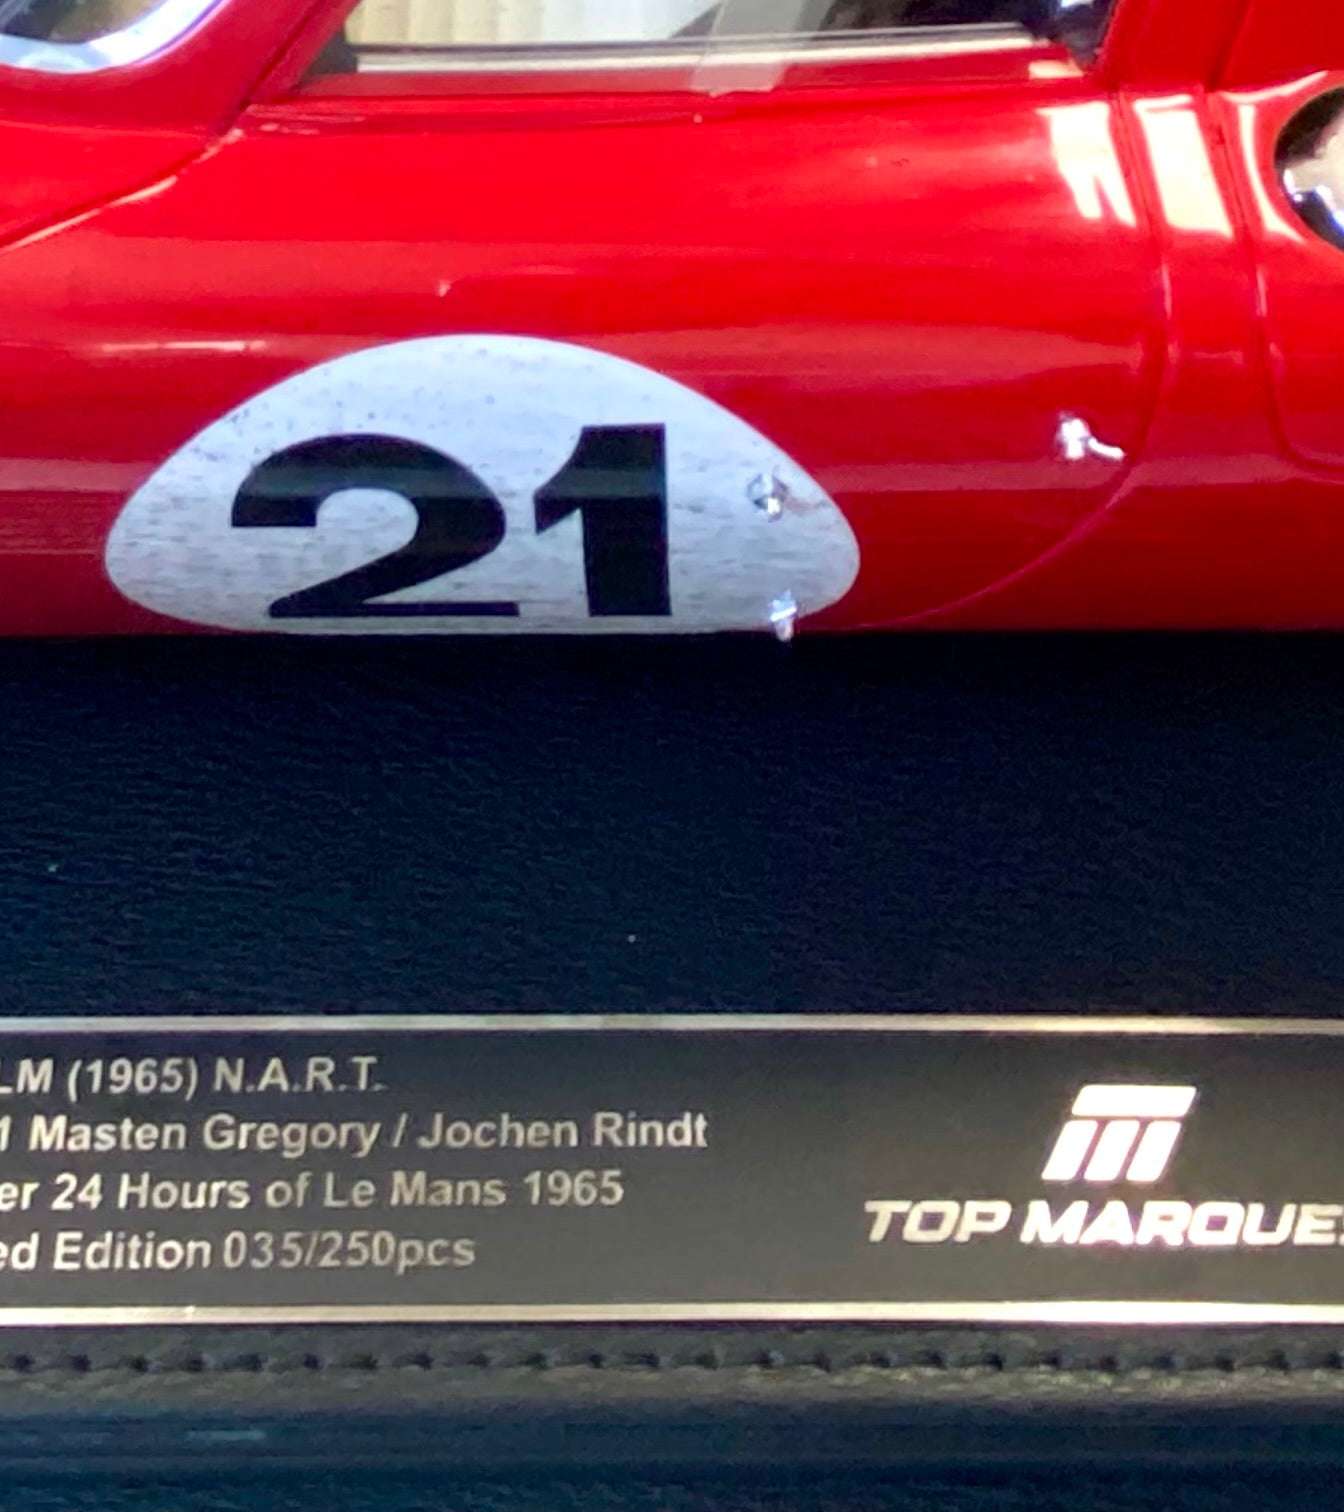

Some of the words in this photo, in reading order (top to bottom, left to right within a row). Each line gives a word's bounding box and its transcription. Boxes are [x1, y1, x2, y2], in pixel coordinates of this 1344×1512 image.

[230, 422, 671, 618] 21
[67, 1057, 198, 1103] (1965)
[213, 1055, 385, 1094] N.A.R.T.
[28, 1114, 187, 1152] Masten
[202, 1113, 382, 1159] Gregory
[391, 1112, 408, 1148] /
[417, 1112, 579, 1149] Jochen
[593, 1111, 708, 1148] Rindt
[50, 1172, 103, 1211] 24
[117, 1171, 251, 1210] Hours
[265, 1171, 312, 1208] of
[323, 1171, 376, 1208] Le
[390, 1170, 508, 1206] Mans
[523, 1169, 625, 1207] 1965
[865, 1199, 1012, 1244] TOP
[52, 1230, 212, 1272] Edition
[222, 1230, 476, 1275] 035/250pcs
